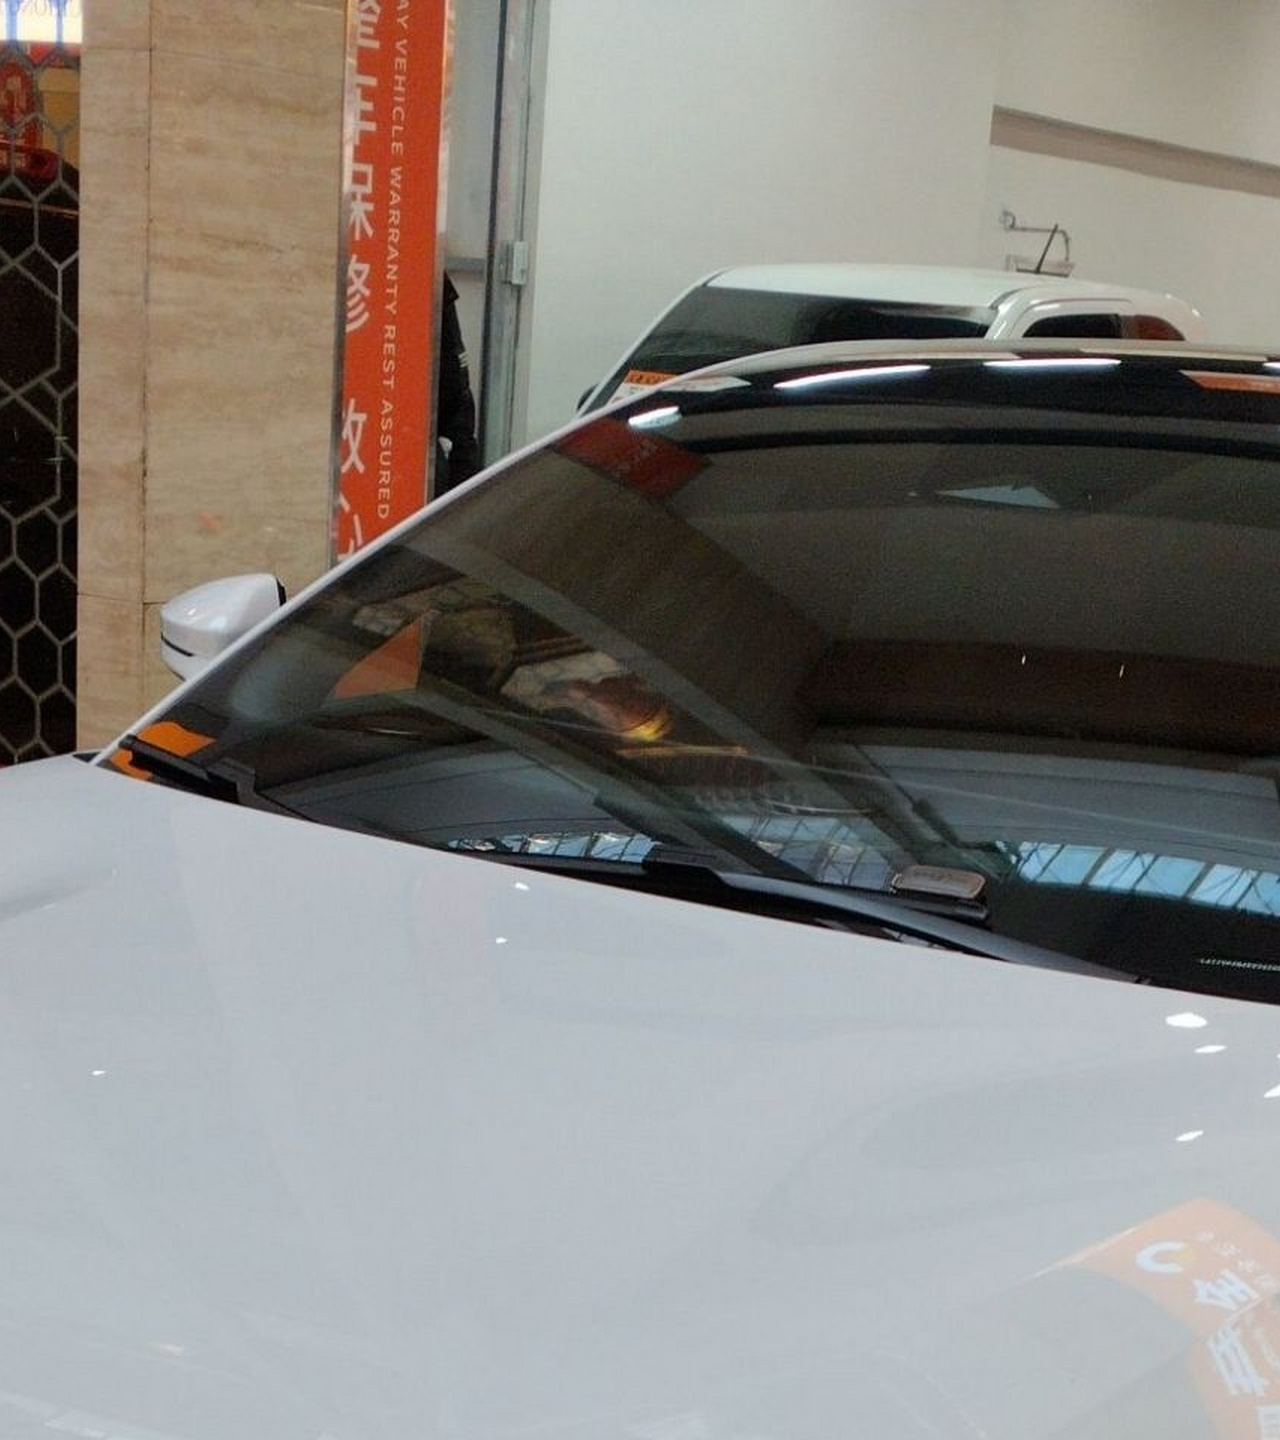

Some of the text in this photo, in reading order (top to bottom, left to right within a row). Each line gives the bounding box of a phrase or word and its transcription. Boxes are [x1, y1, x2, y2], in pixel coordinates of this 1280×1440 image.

[389, 38, 409, 156] VEHICLE
[384, 166, 404, 317] WARRANTY
[383, 324, 397, 390] REST
[377, 399, 394, 520] ASSURED
